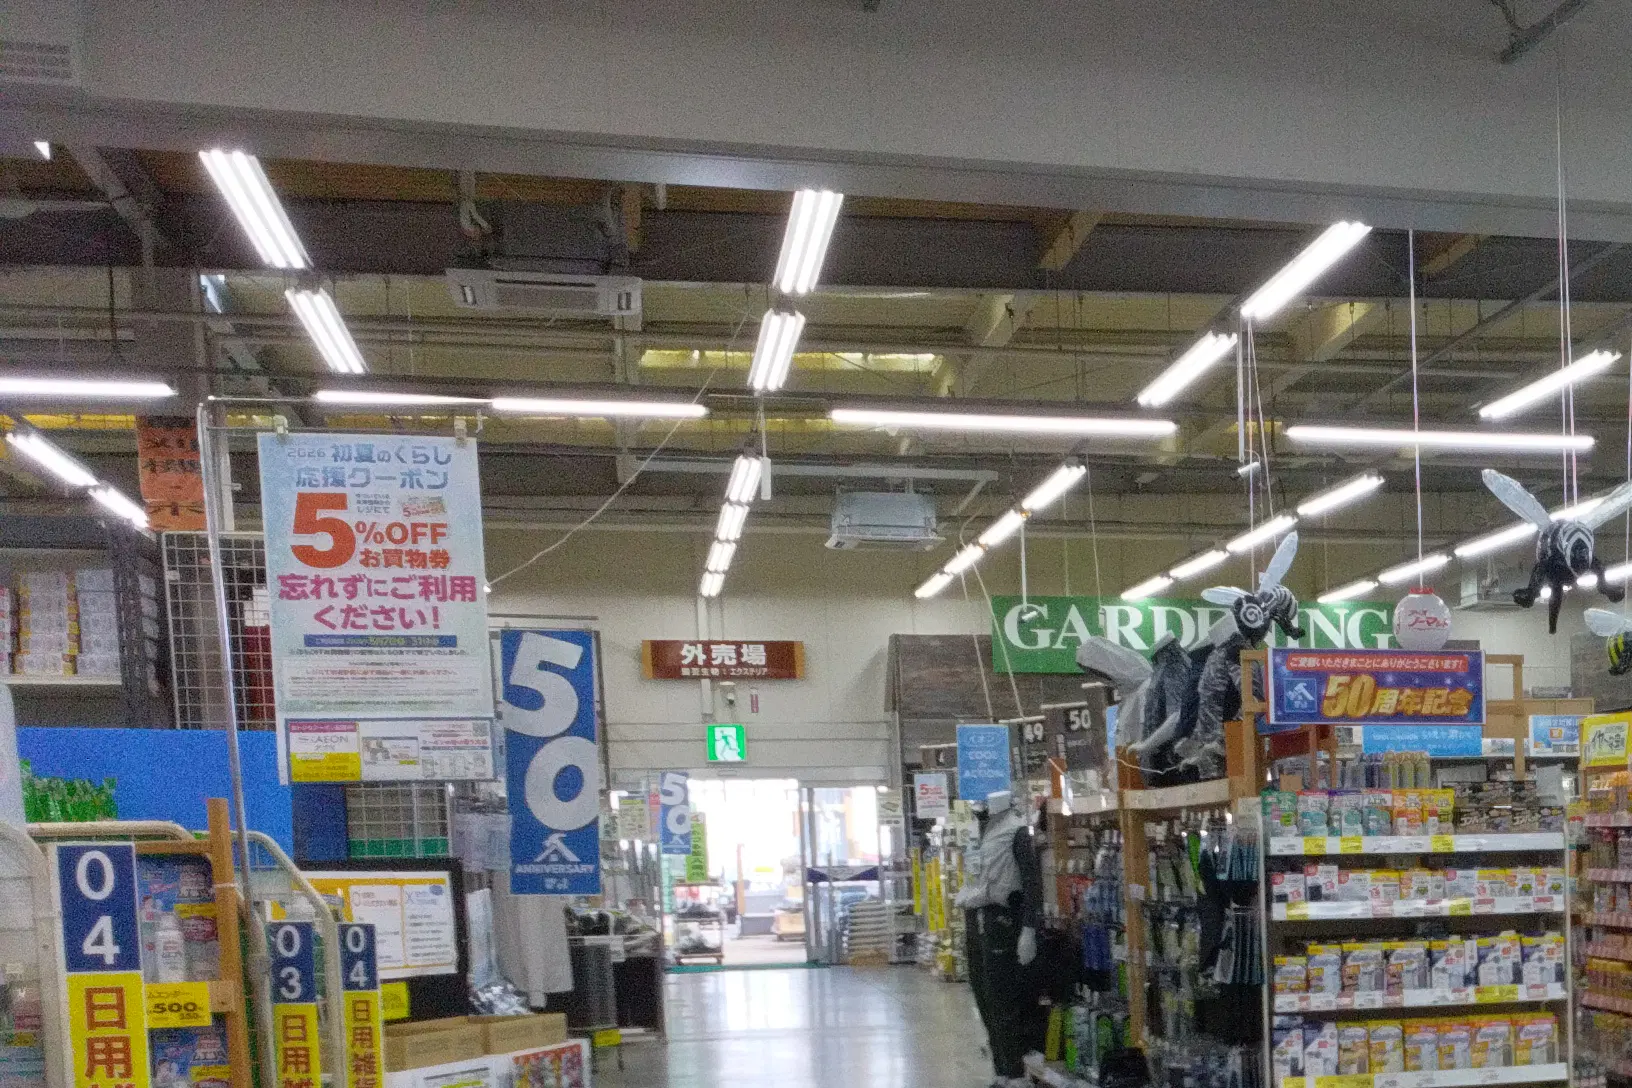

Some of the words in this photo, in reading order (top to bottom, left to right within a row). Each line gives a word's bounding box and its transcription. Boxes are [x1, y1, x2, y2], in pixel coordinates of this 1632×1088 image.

[331, 443, 451, 465] 初夏のくらし
[296, 466, 448, 488] 応援クーポン
[290, 492, 356, 568] 5
[355, 521, 447, 544] %OFF
[359, 549, 450, 568] お買物券
[277, 573, 477, 601] 忘れずにご利用
[314, 604, 440, 630] ください!
[681, 644, 766, 665] 外売場
[1322, 674, 1474, 718] 50周年記念
[502, 632, 599, 831] 50
[1069, 709, 1091, 730] 50
[1023, 722, 1044, 743] 49
[77, 850, 120, 964] 04
[276, 924, 302, 999] 03
[347, 926, 369, 988] 04
[153, 1002, 197, 1014] 500
